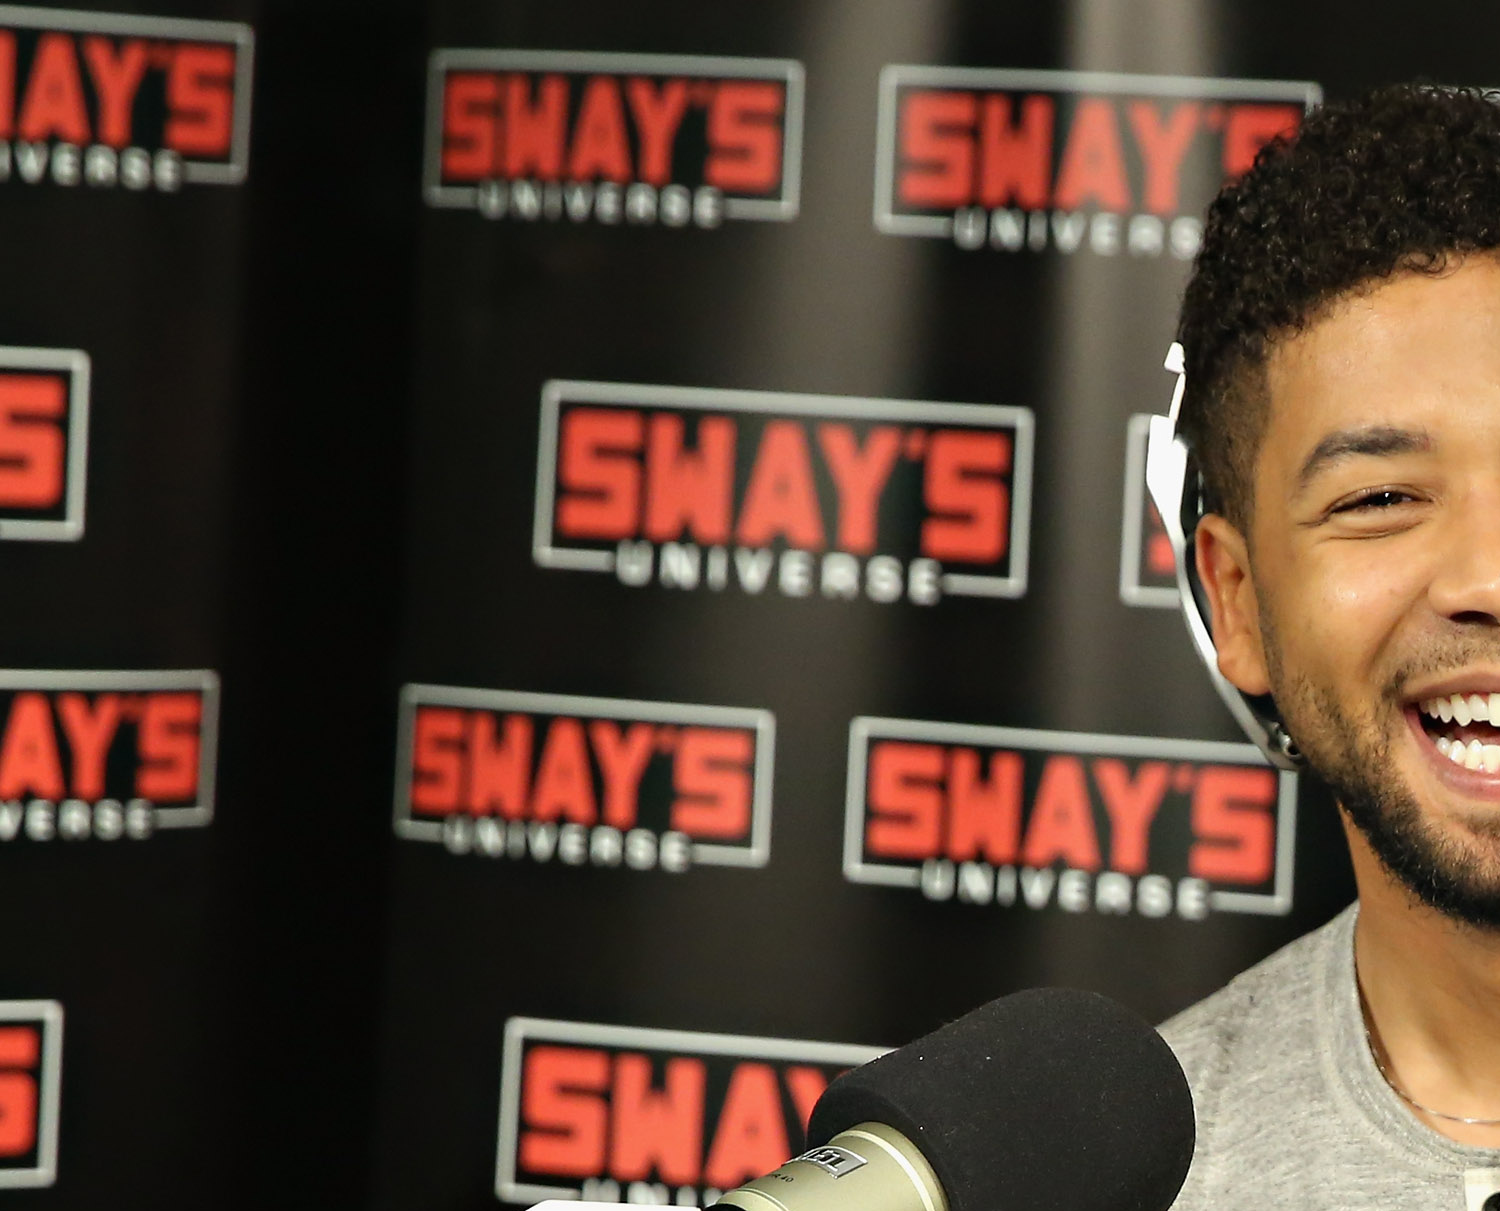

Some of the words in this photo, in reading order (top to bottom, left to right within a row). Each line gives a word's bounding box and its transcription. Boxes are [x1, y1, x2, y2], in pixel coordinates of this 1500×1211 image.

[0, 29, 235, 155] AY'S
[440, 72, 786, 193] SWAY'S
[478, 181, 723, 228] UNIVERSE
[952, 205, 1204, 260] UNIVERS
[556, 406, 1012, 564] SWAY'S
[615, 539, 943, 606] UNIVERSE
[408, 704, 754, 841] SWAY'S
[864, 739, 1277, 886] SWAY'S
[441, 814, 693, 872] UNIVERSE
[920, 858, 1210, 921] UNIVERSE
